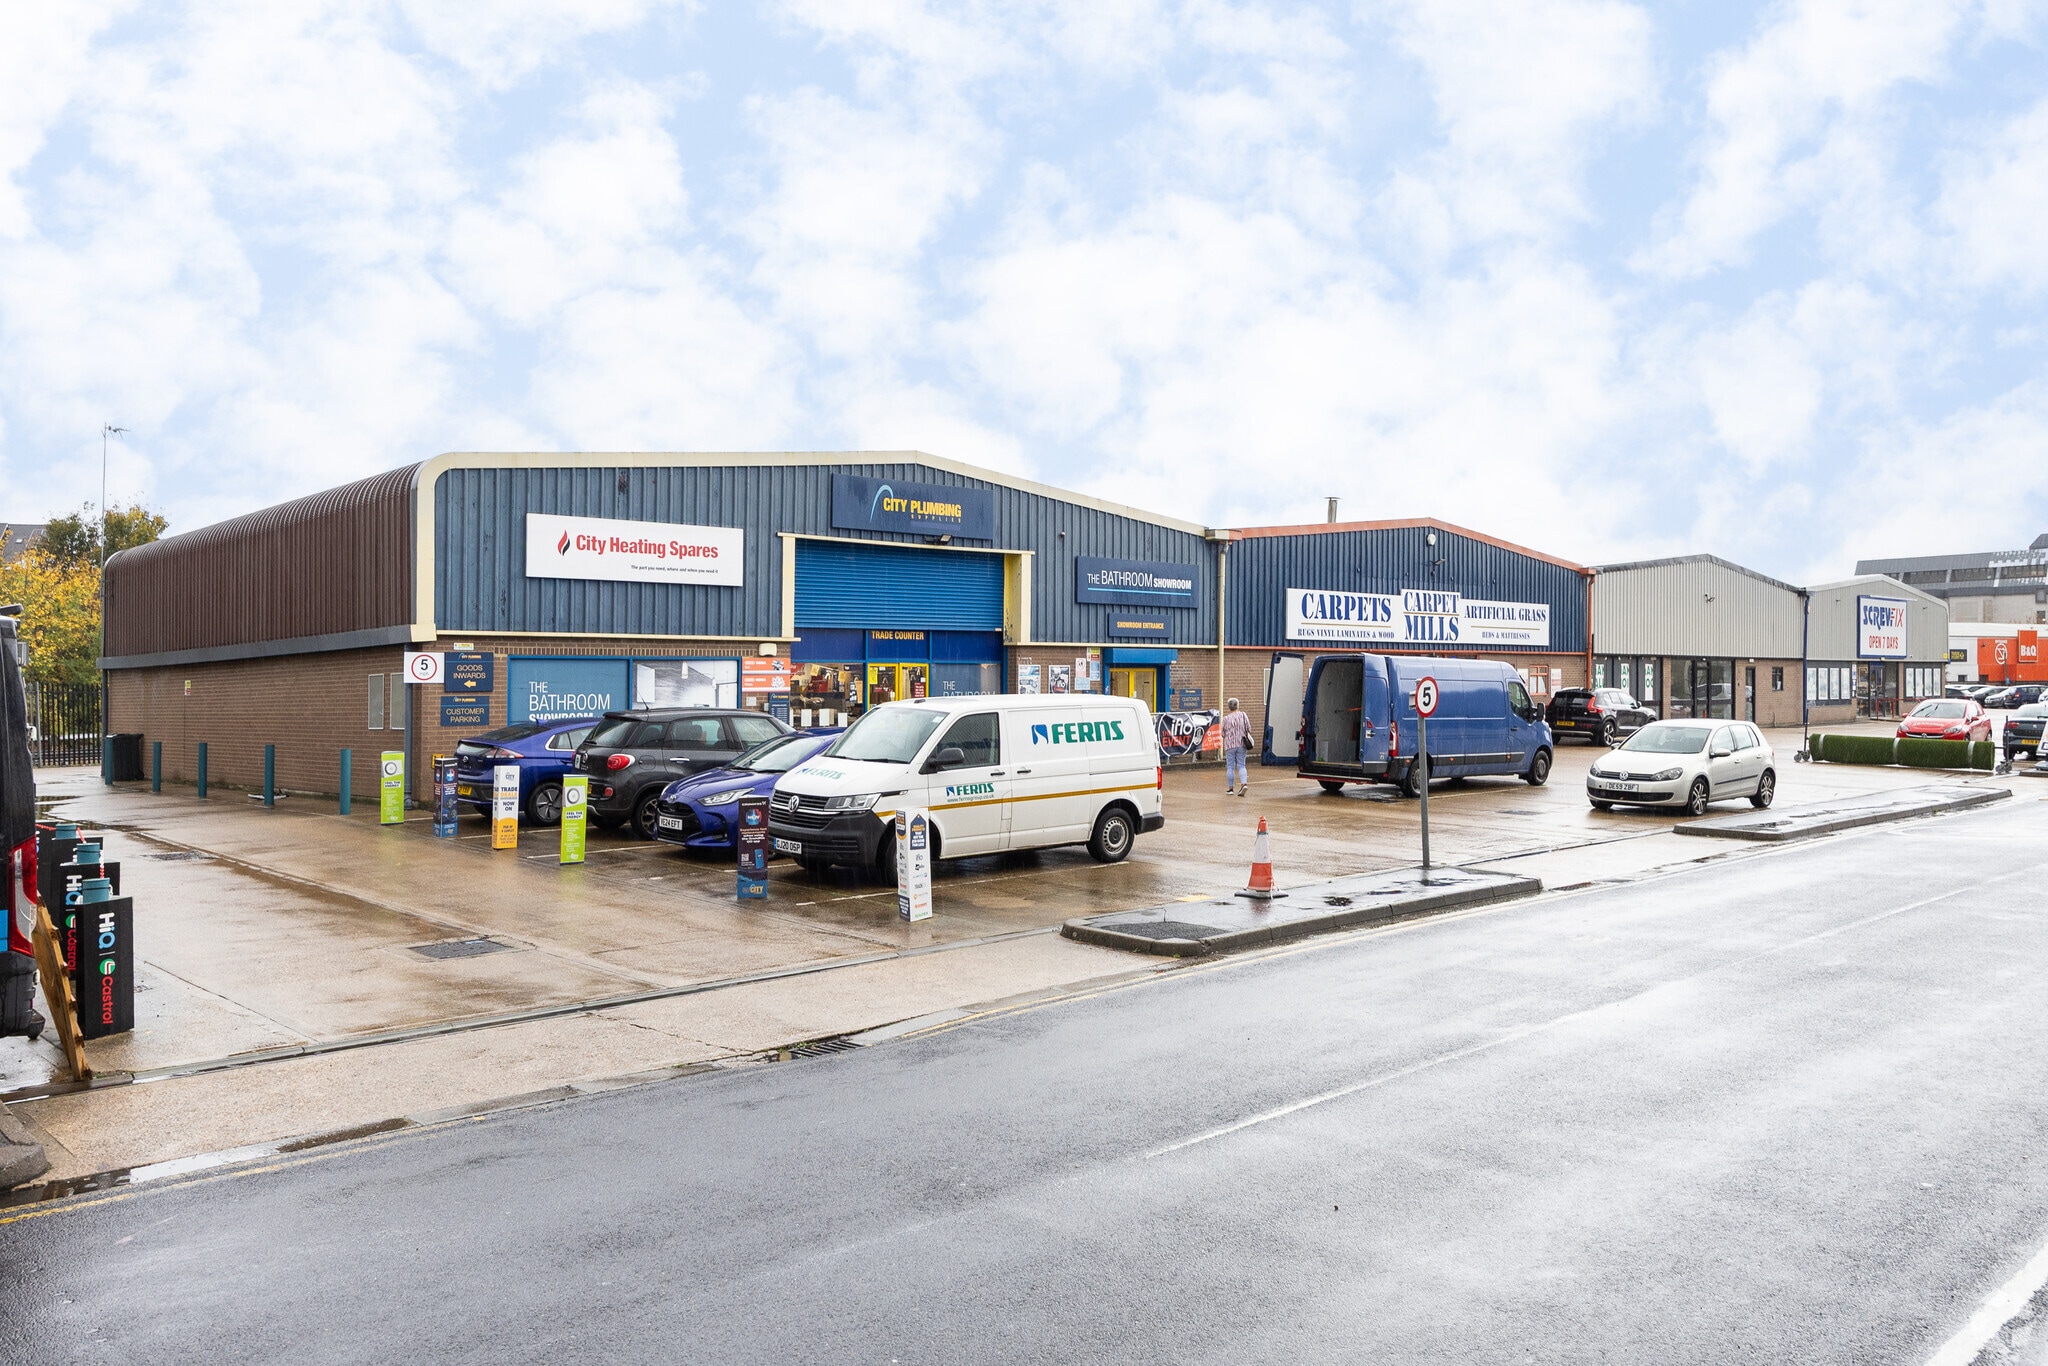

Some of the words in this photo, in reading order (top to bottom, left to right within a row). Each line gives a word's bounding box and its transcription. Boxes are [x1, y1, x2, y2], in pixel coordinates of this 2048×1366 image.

[883, 497, 907, 512] CITY
[910, 500, 962, 518] PLUMBING
[911, 514, 962, 523] SUPPLIES
[576, 534, 607, 555] City
[609, 537, 666, 558] Heating
[669, 541, 719, 559] Spares
[1087, 573, 1100, 584] THE
[1101, 570, 1153, 588] BATHROOM
[1153, 577, 1192, 590] SHOWROOM
[1301, 593, 1392, 623] CARPETS
[1403, 591, 1459, 613] CARPET
[1464, 605, 1516, 620] ARTIFICIAL
[1518, 608, 1546, 622] GRASS
[1863, 605, 1904, 630] SCREWFIX
[871, 631, 893, 640] TRADE
[894, 631, 924, 640] COUNTER
[1297, 628, 1315, 637] RUGS
[1316, 629, 1335, 637] VINYL
[1336, 630, 1370, 638] LAMINATES
[1378, 631, 1395, 639] WOOD
[1404, 614, 1459, 642] MILLS
[1482, 631, 1495, 639] BEDS
[1868, 635, 1881, 648] OPEN
[1882, 636, 1886, 649] 7
[1886, 636, 1899, 649] DAYS
[2020, 645, 2037, 656] B&Q
[420, 659, 429, 671] 5
[528, 681, 548, 693] THE
[942, 680, 955, 691] THE
[529, 693, 610, 711] BATHROOM
[1422, 686, 1431, 707] 5
[446, 707, 485, 716] CUSTOMER
[1052, 720, 1125, 744] FERNS
[1162, 735, 1192, 747] EVENT
[808, 768, 846, 780] FERNS
[956, 782, 994, 796] FERNS
[98, 912, 116, 949] HiQ
[102, 976, 114, 1025] Castrol
